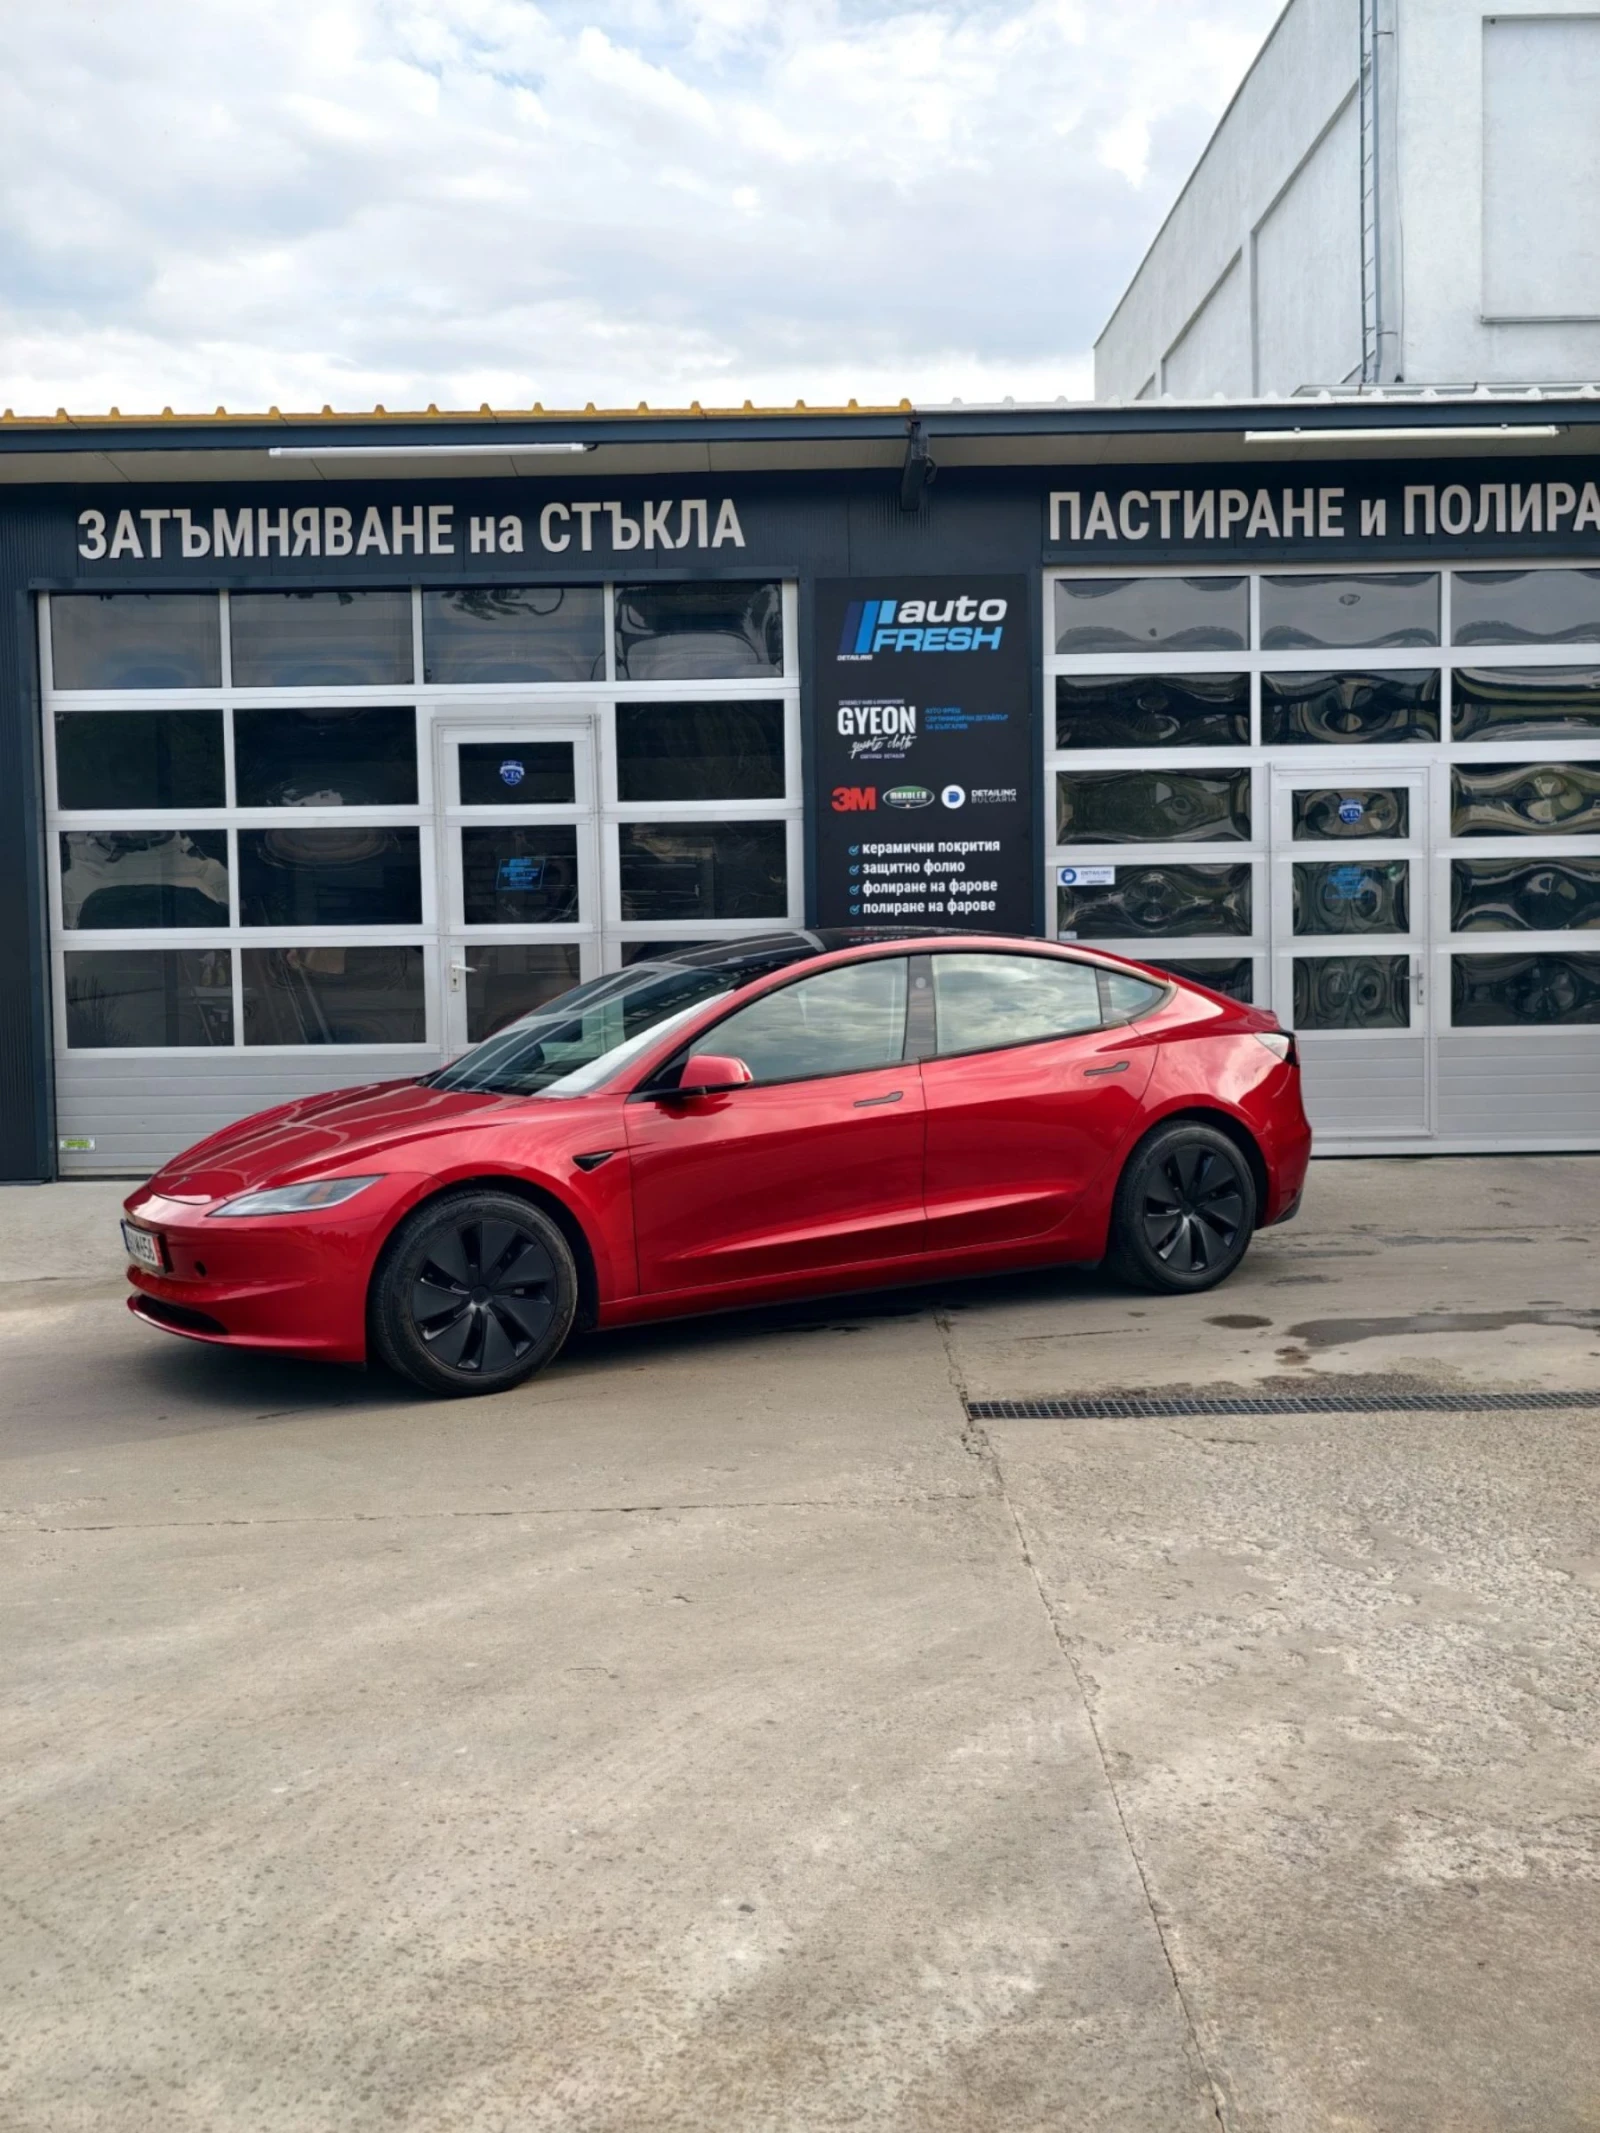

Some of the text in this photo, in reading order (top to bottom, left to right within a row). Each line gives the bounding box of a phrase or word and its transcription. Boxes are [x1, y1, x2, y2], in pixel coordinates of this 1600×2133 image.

[1049, 487, 1345, 541] ПАСТИРАНЕ
[1360, 499, 1387, 538] и
[78, 499, 746, 560] ЗАТЪМНЯВАНЕ на СТЪКЛА
[897, 595, 1008, 624] auto
[872, 626, 1003, 652] FRESH
[837, 705, 916, 736] GYEON
[831, 786, 877, 812] 3M
[971, 789, 1017, 797] DETAILING
[862, 841, 1000, 857] керамични покрития
[862, 859, 966, 876] защитно фолио
[862, 878, 998, 897] фолиране на фарове
[863, 898, 996, 916] полиране на фарове
